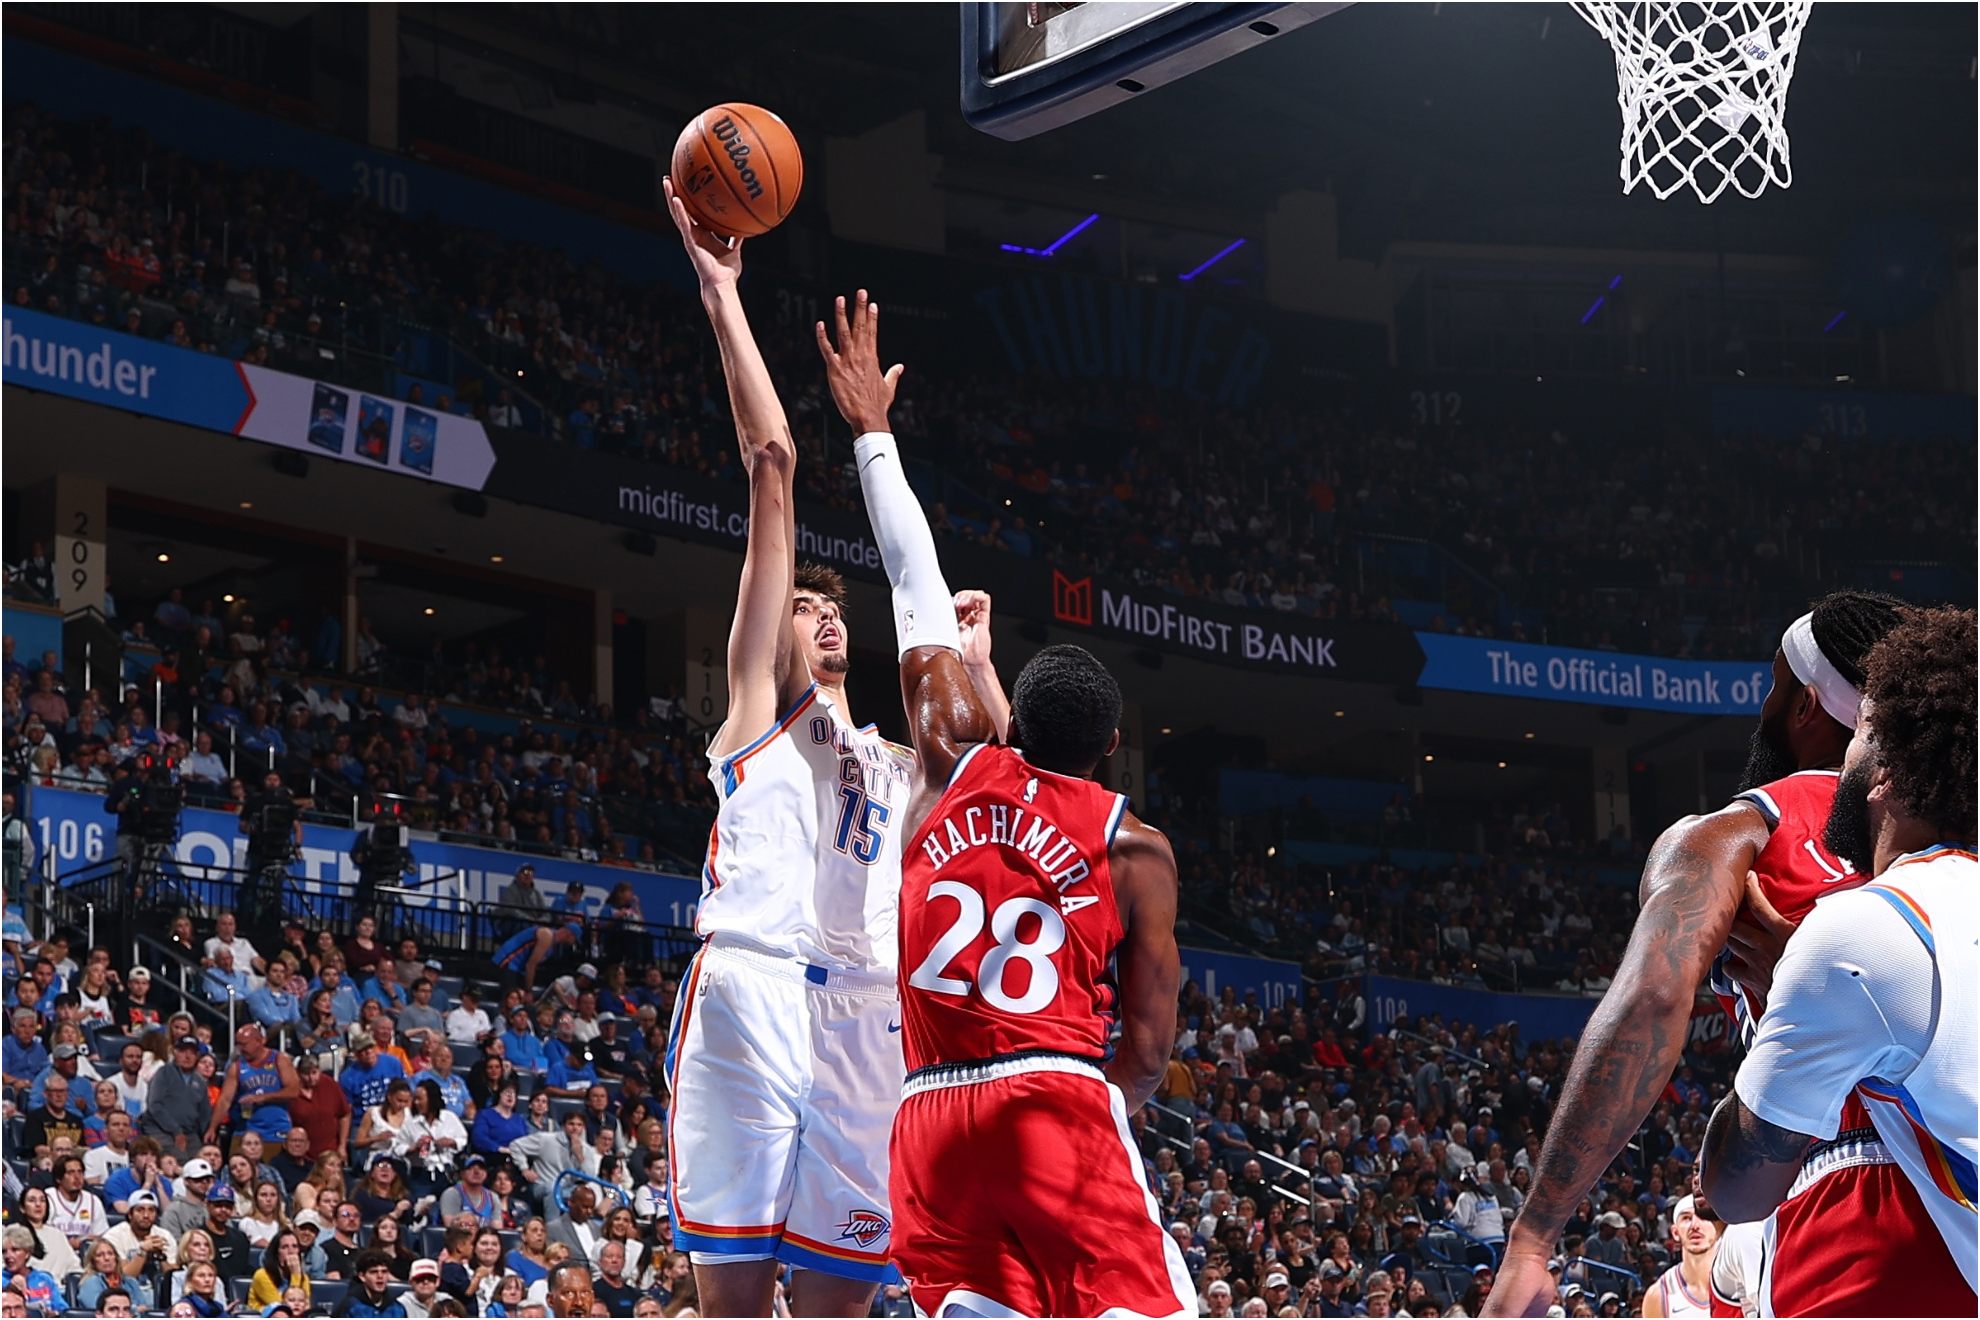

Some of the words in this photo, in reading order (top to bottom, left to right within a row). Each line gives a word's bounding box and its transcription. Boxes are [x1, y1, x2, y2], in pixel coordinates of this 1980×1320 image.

[352, 159, 409, 215] 310
[713, 115, 764, 201] Wilson
[776, 288, 818, 332] 311
[973, 273, 1272, 405] THUNDER
[3, 319, 157, 399] hunder
[72, 511, 88, 592] 209
[701, 647, 713, 717] 210
[1487, 651, 1538, 687] The
[1547, 657, 1643, 697] Official
[1652, 668, 1720, 703] Bank
[1731, 672, 1763, 704] of
[840, 756, 893, 803] CITY
[38, 816, 104, 863] 106
[833, 783, 893, 866] 15
[922, 804, 1099, 916] HACHIMURA
[908, 880, 1066, 1014] 28
[1687, 1012, 1725, 1043] KC
[843, 1220, 882, 1236] OKC
